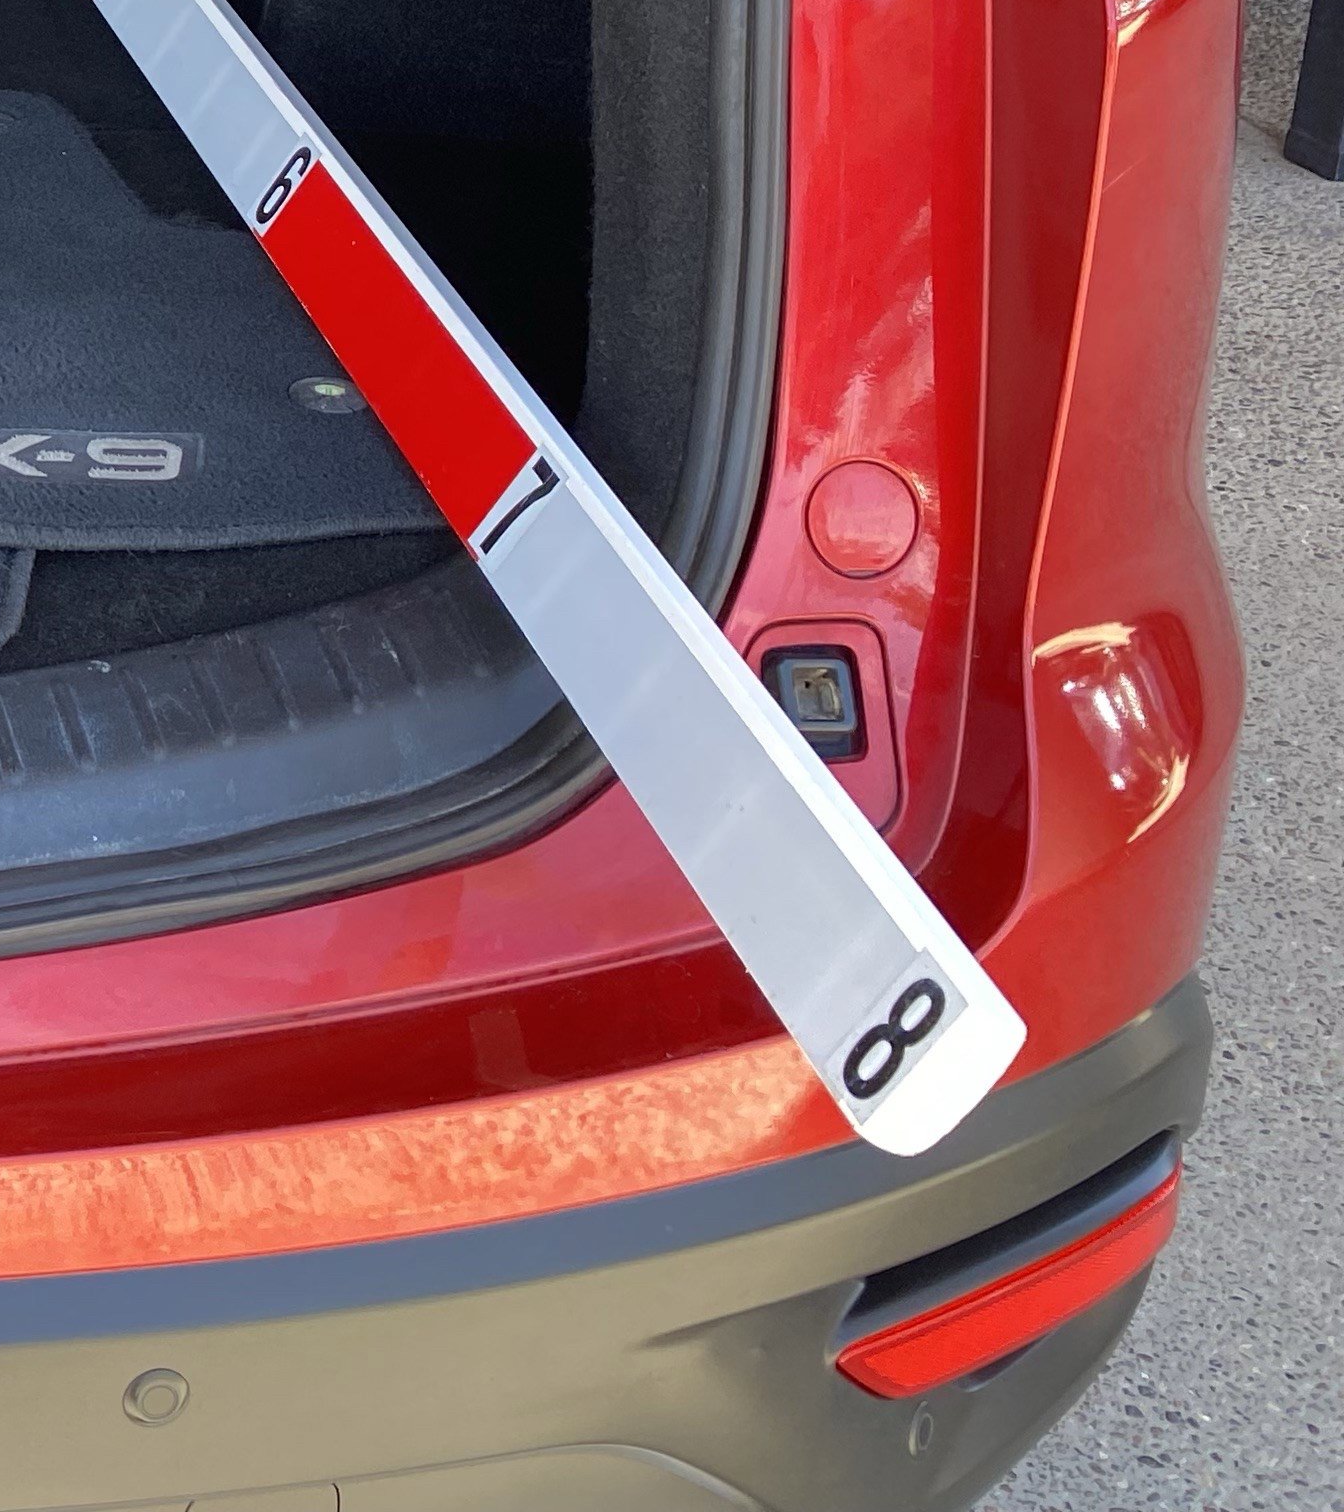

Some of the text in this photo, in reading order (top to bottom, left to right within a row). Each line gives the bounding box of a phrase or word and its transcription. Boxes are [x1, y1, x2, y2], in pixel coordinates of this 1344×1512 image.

[255, 146, 312, 225] 6
[479, 456, 561, 555] 7
[842, 978, 946, 1100] 8
